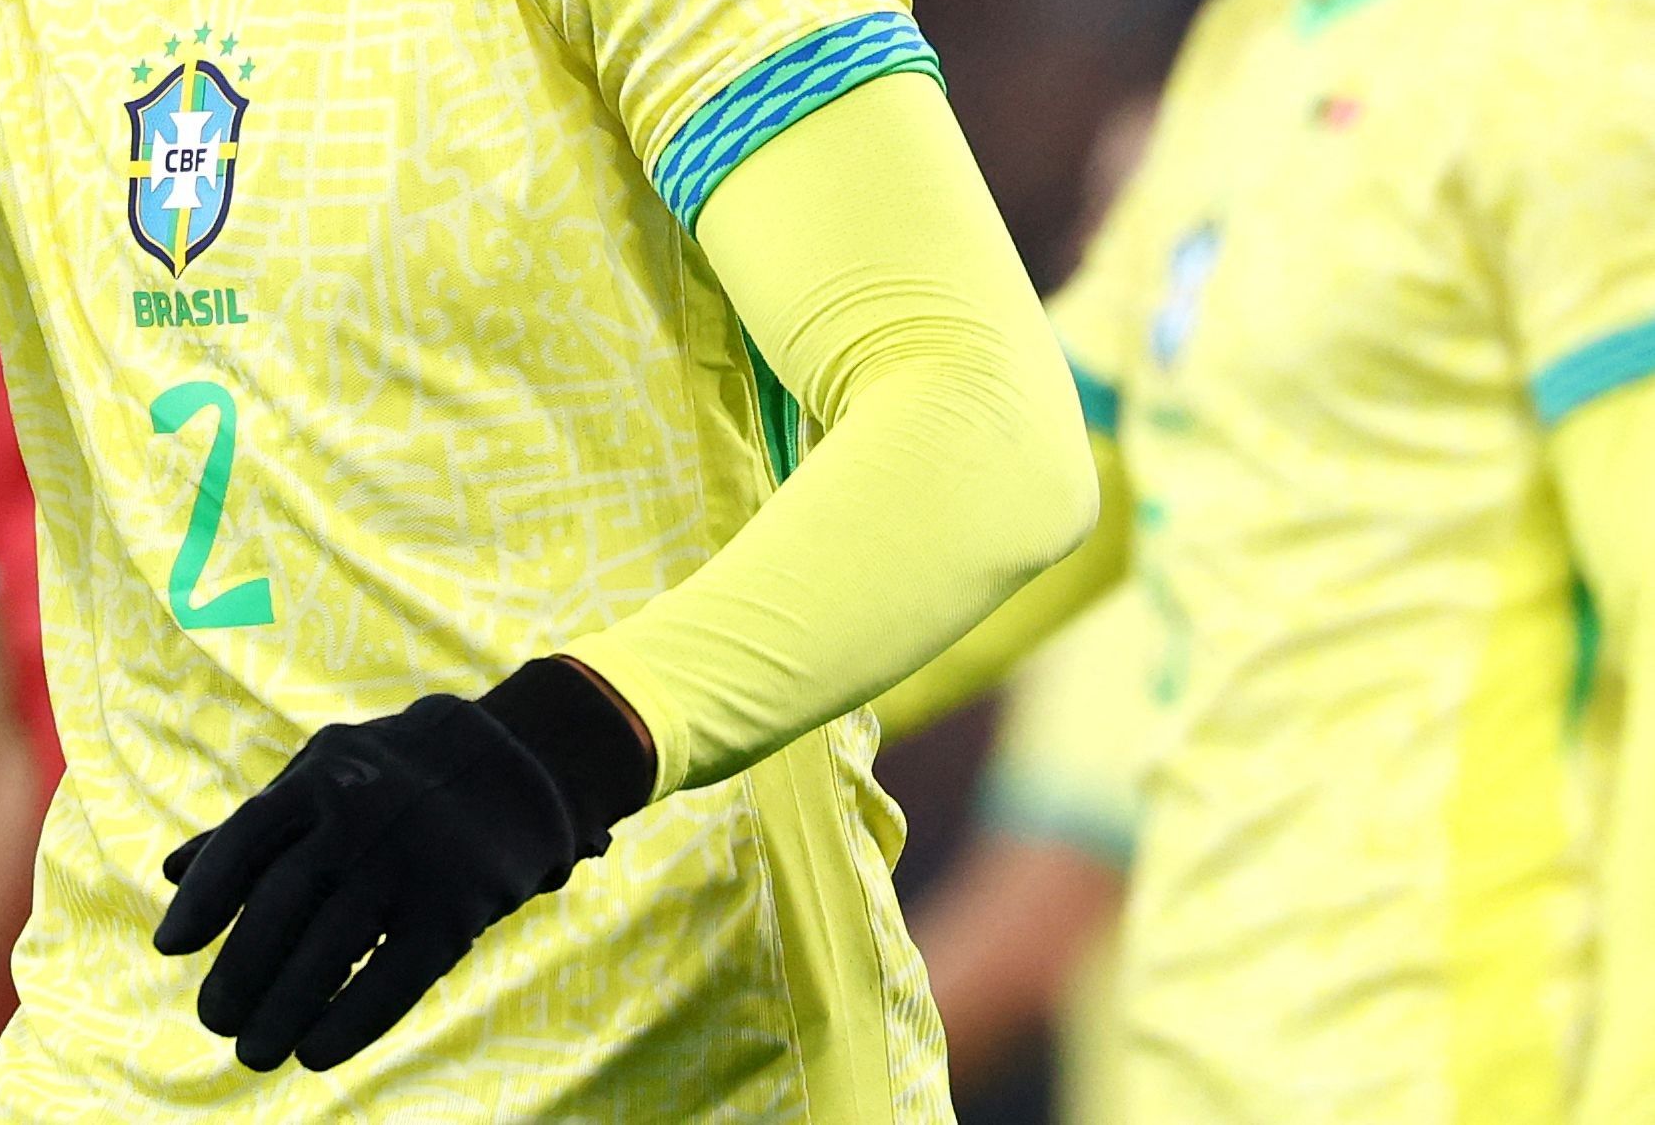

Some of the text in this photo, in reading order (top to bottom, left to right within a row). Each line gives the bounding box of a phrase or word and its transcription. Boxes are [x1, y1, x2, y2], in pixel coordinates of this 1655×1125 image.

[164, 148, 207, 173] CBF
[132, 287, 249, 328] BRASIL
[149, 380, 275, 630] 2
